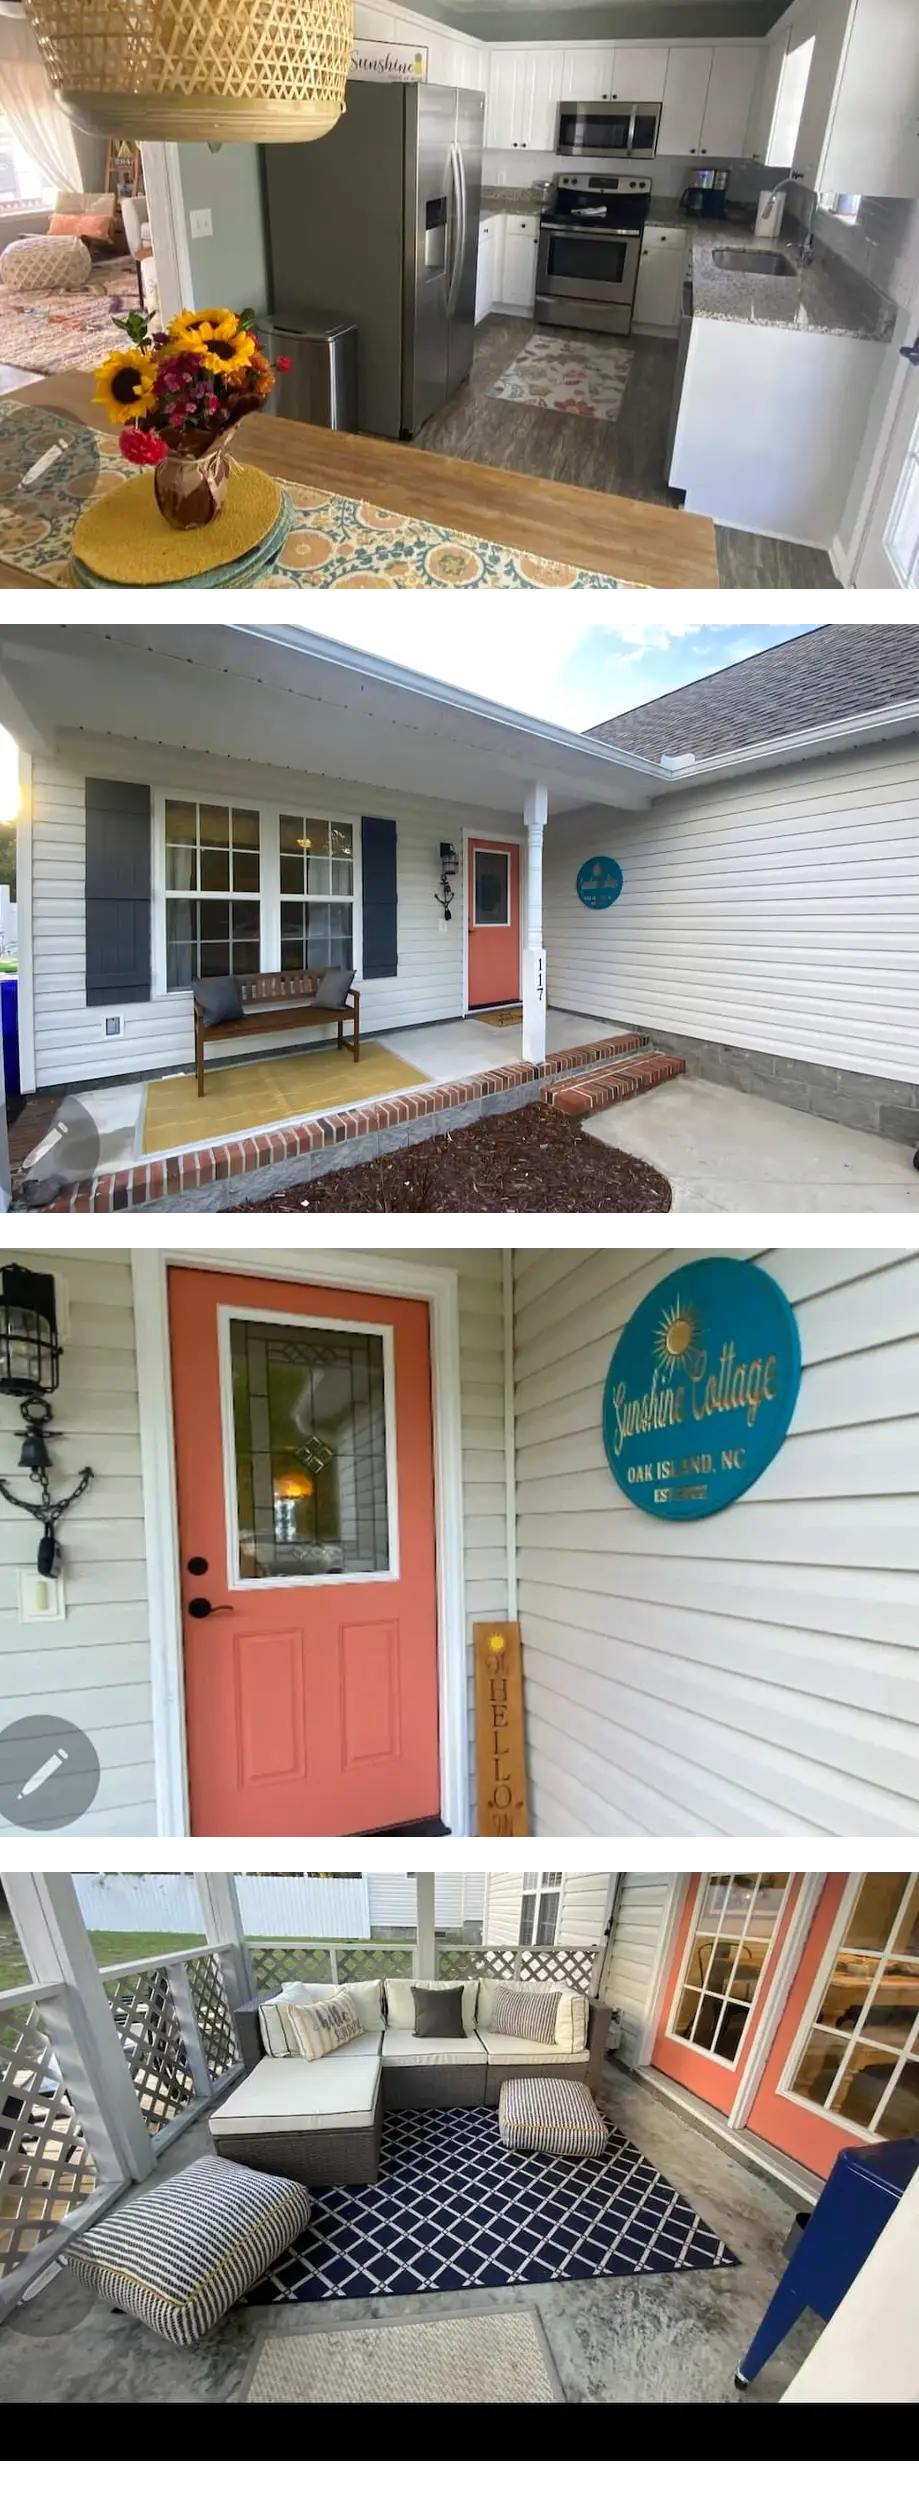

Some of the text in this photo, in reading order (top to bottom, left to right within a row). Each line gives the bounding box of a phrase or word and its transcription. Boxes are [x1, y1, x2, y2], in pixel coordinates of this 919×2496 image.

[351, 49, 414, 73] Sunshine
[613, 1340, 776, 1456] Sunshine Cottage
[627, 1463, 653, 1484] OAK
[721, 1448, 746, 1471] NC
[489, 1678, 513, 1810] HELLO
